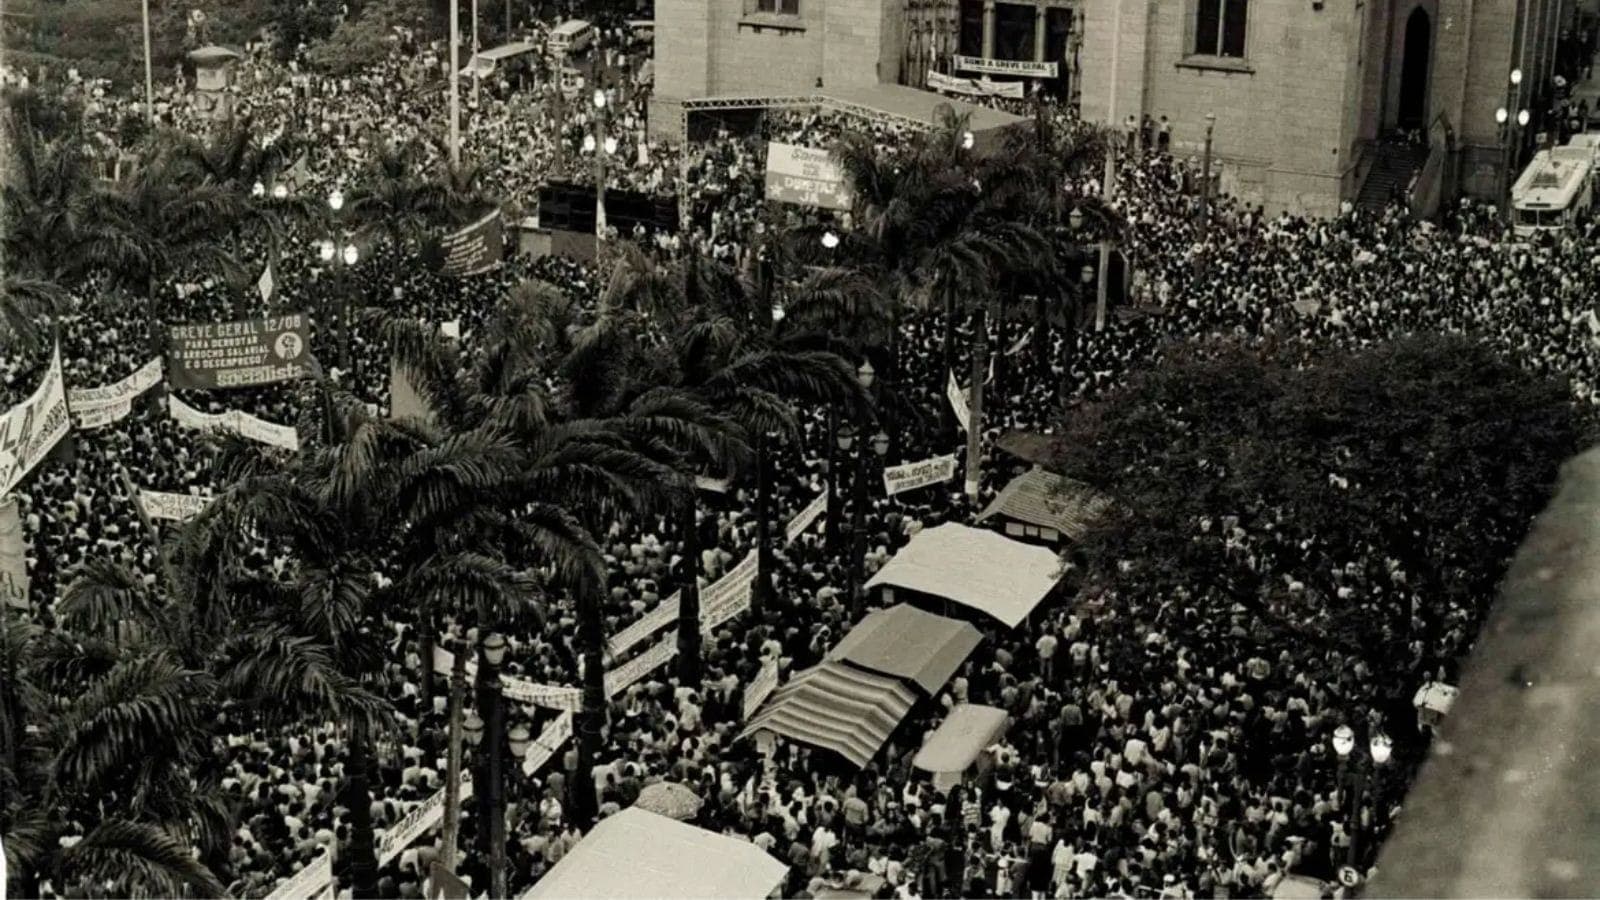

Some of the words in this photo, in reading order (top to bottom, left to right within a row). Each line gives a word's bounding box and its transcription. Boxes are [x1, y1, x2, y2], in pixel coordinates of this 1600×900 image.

[171, 326, 213, 340] GREVE
[217, 322, 259, 337] GERAL
[185, 340, 209, 349] PARA
[184, 360, 192, 369] E
